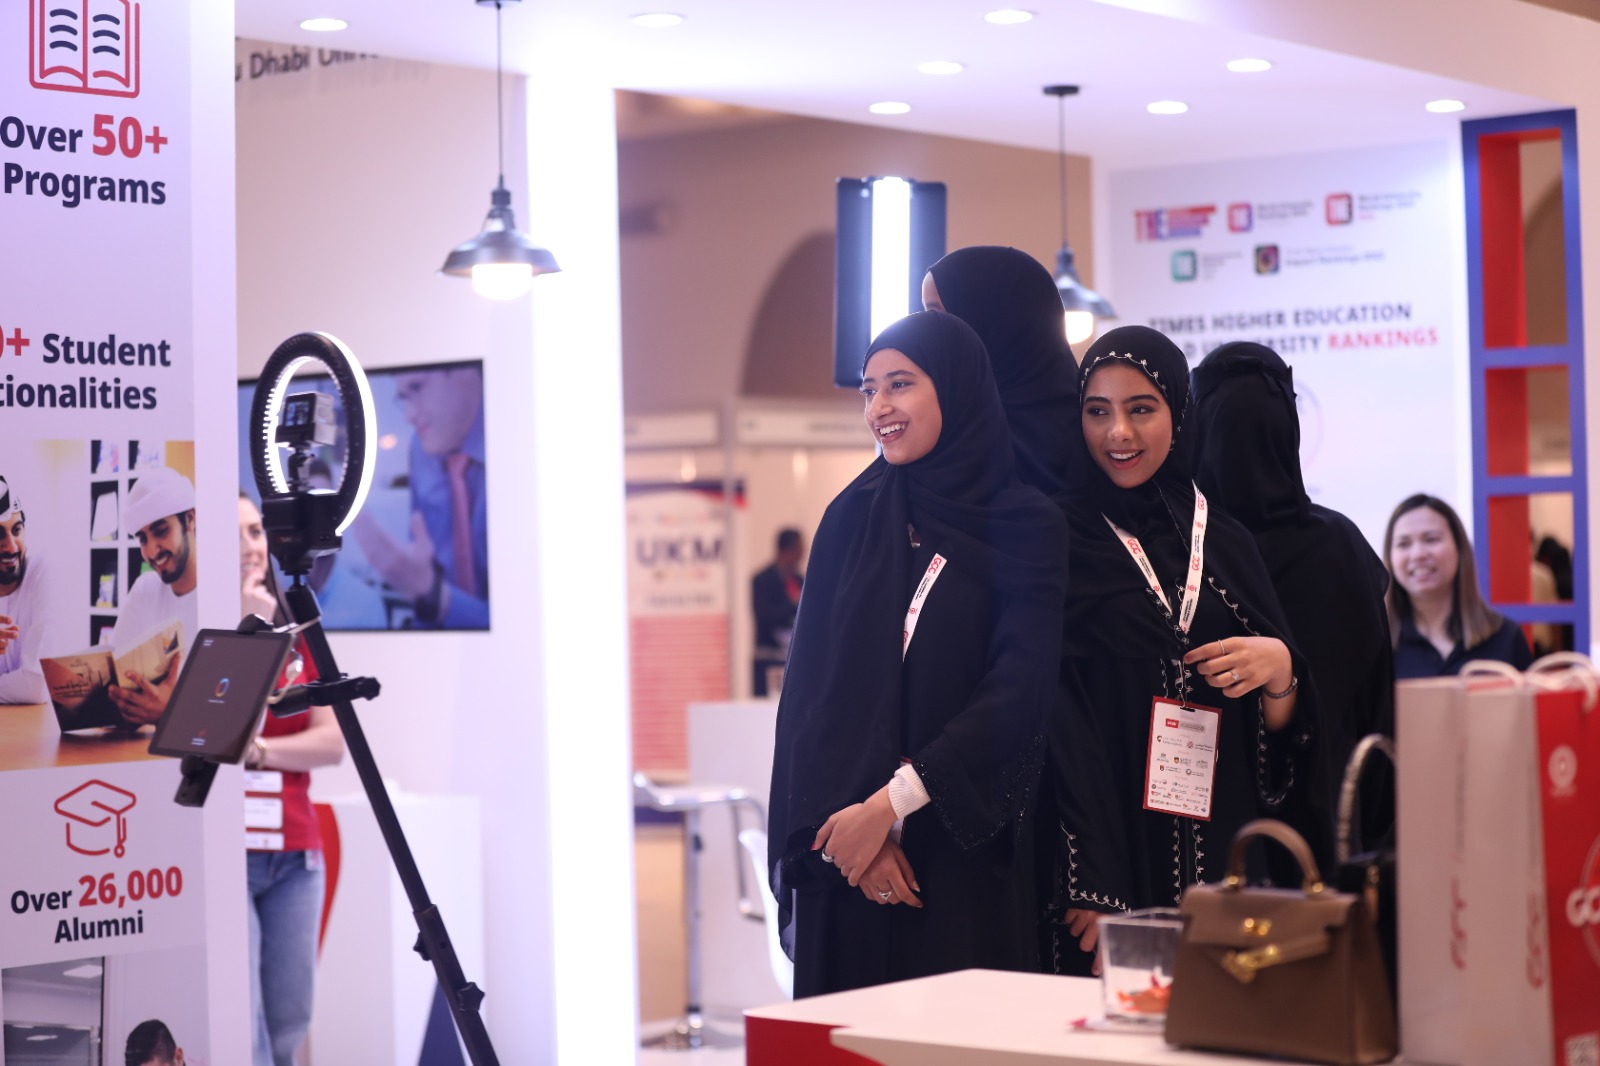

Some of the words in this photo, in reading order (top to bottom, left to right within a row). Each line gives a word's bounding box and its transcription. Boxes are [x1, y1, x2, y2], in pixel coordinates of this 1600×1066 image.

[250, 46, 309, 79] Dhabi
[0, 115, 83, 153] Over
[93, 113, 168, 158] 50+
[4, 162, 166, 208] Programs
[1212, 310, 1286, 331] HIGHER
[1293, 302, 1412, 326] EDUCATION
[43, 333, 171, 367] Student
[1328, 327, 1438, 349] RANKINGS
[636, 537, 723, 567] UKM
[1127, 539, 1142, 554] GCC
[928, 557, 942, 574] GCC
[1191, 554, 1201, 571] GCC
[10, 890, 72, 914] Over
[78, 866, 183, 908] 26,000
[54, 909, 144, 943] Alumni
